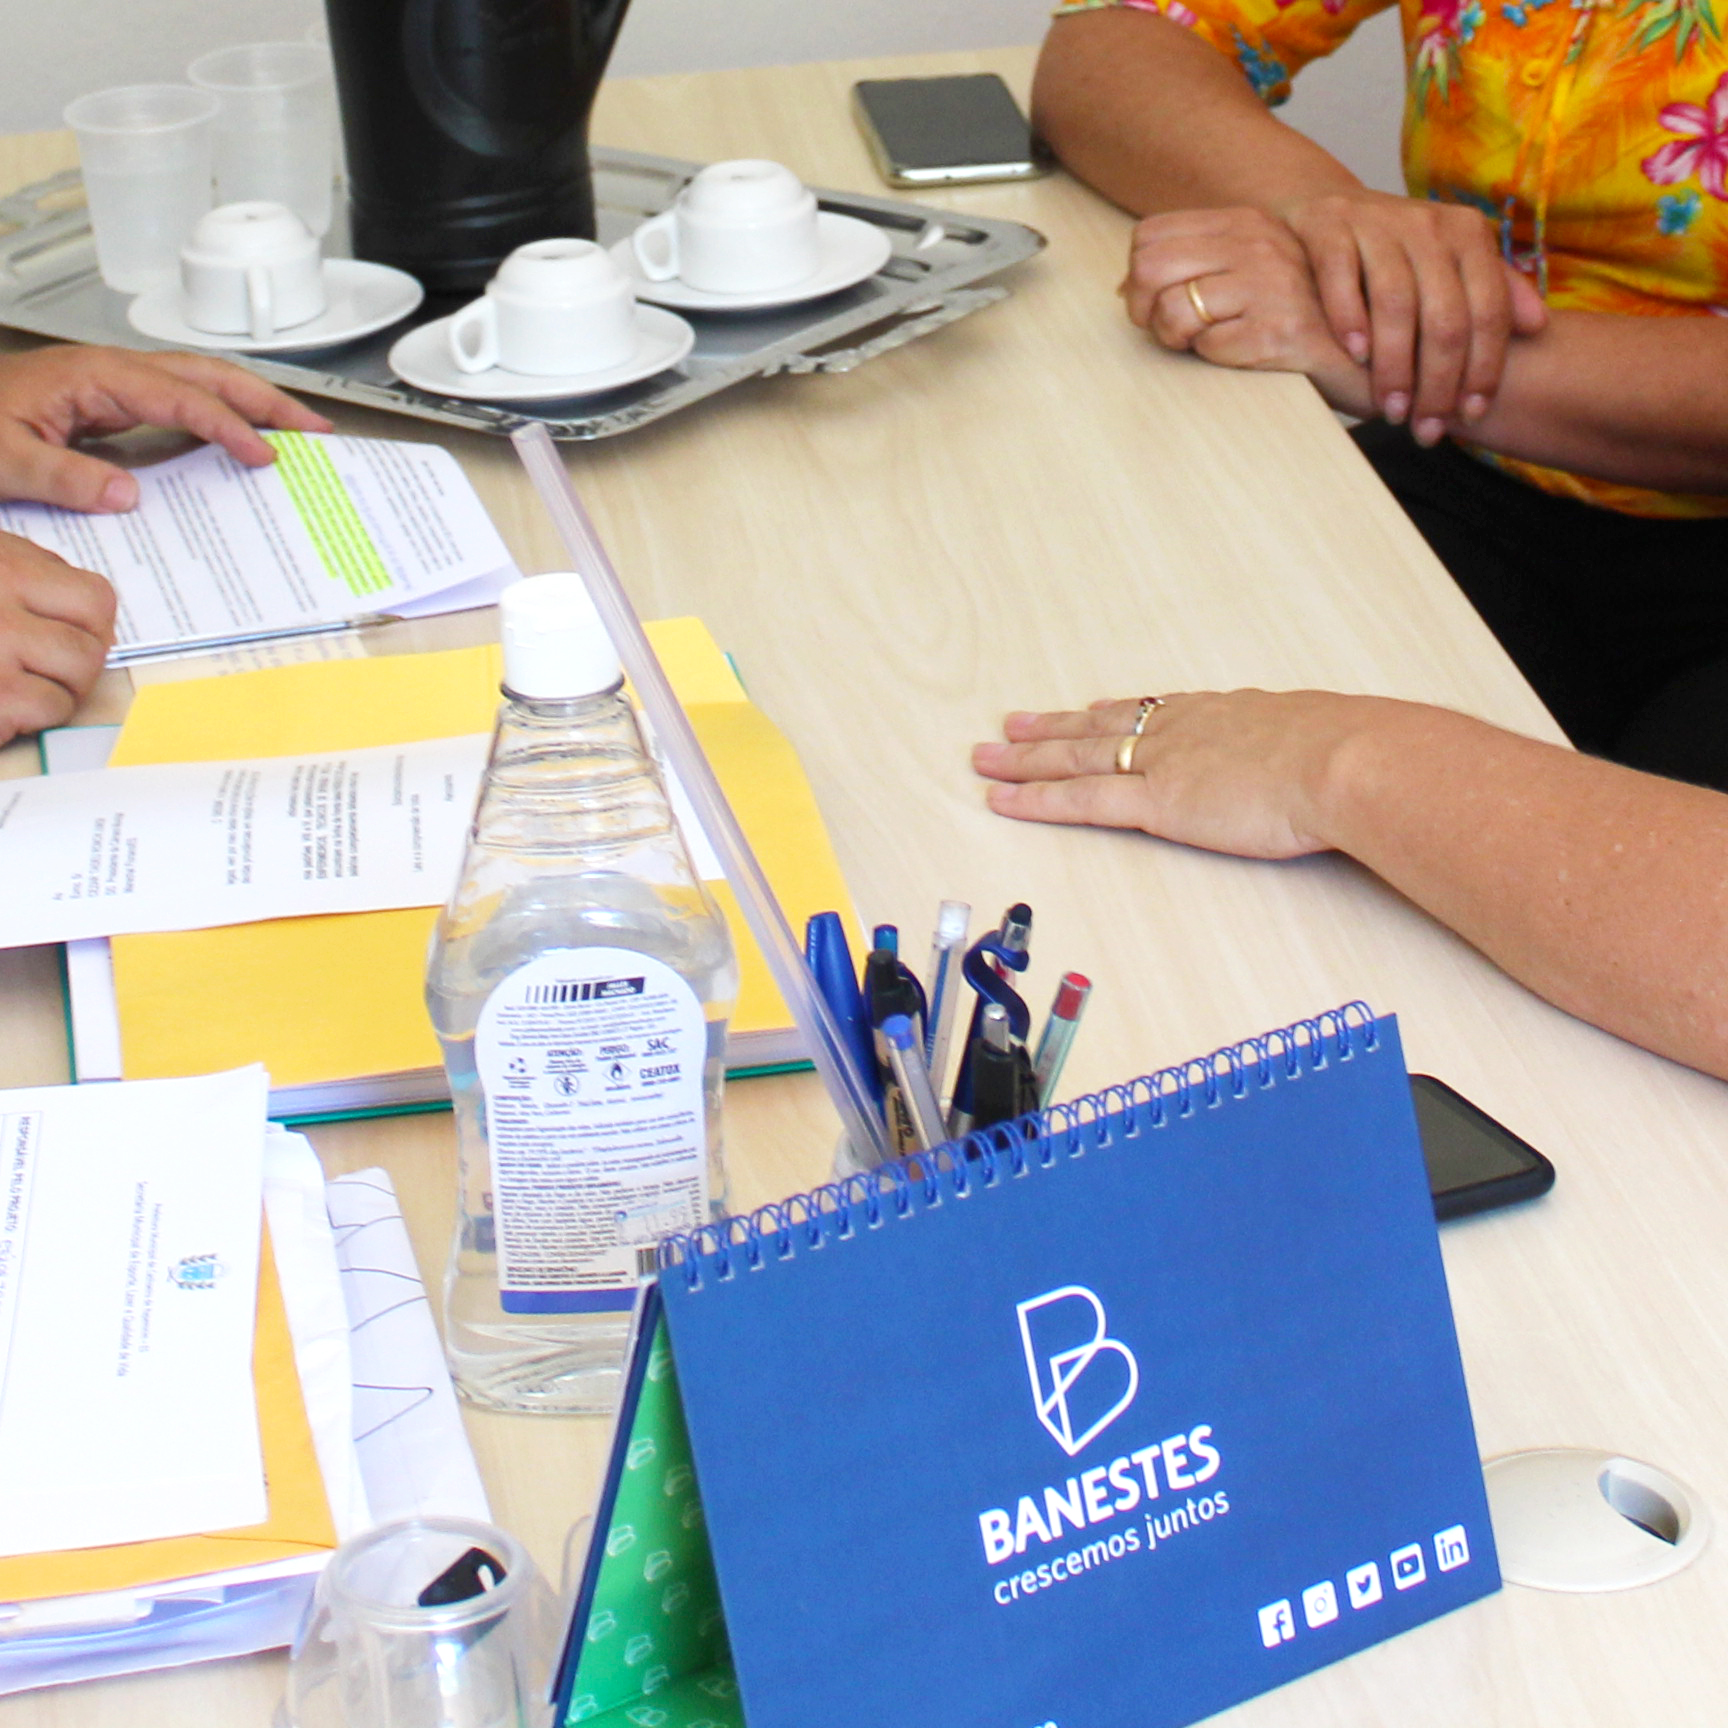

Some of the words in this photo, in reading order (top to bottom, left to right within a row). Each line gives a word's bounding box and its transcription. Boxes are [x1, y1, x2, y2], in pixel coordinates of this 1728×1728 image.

[639, 1063, 681, 1079] CEATOX
[646, 1036, 669, 1051] SAC
[976, 1423, 1222, 1567] BANESTES
[993, 1526, 1141, 1606] crescemos
[1145, 1487, 1230, 1553] juntos
